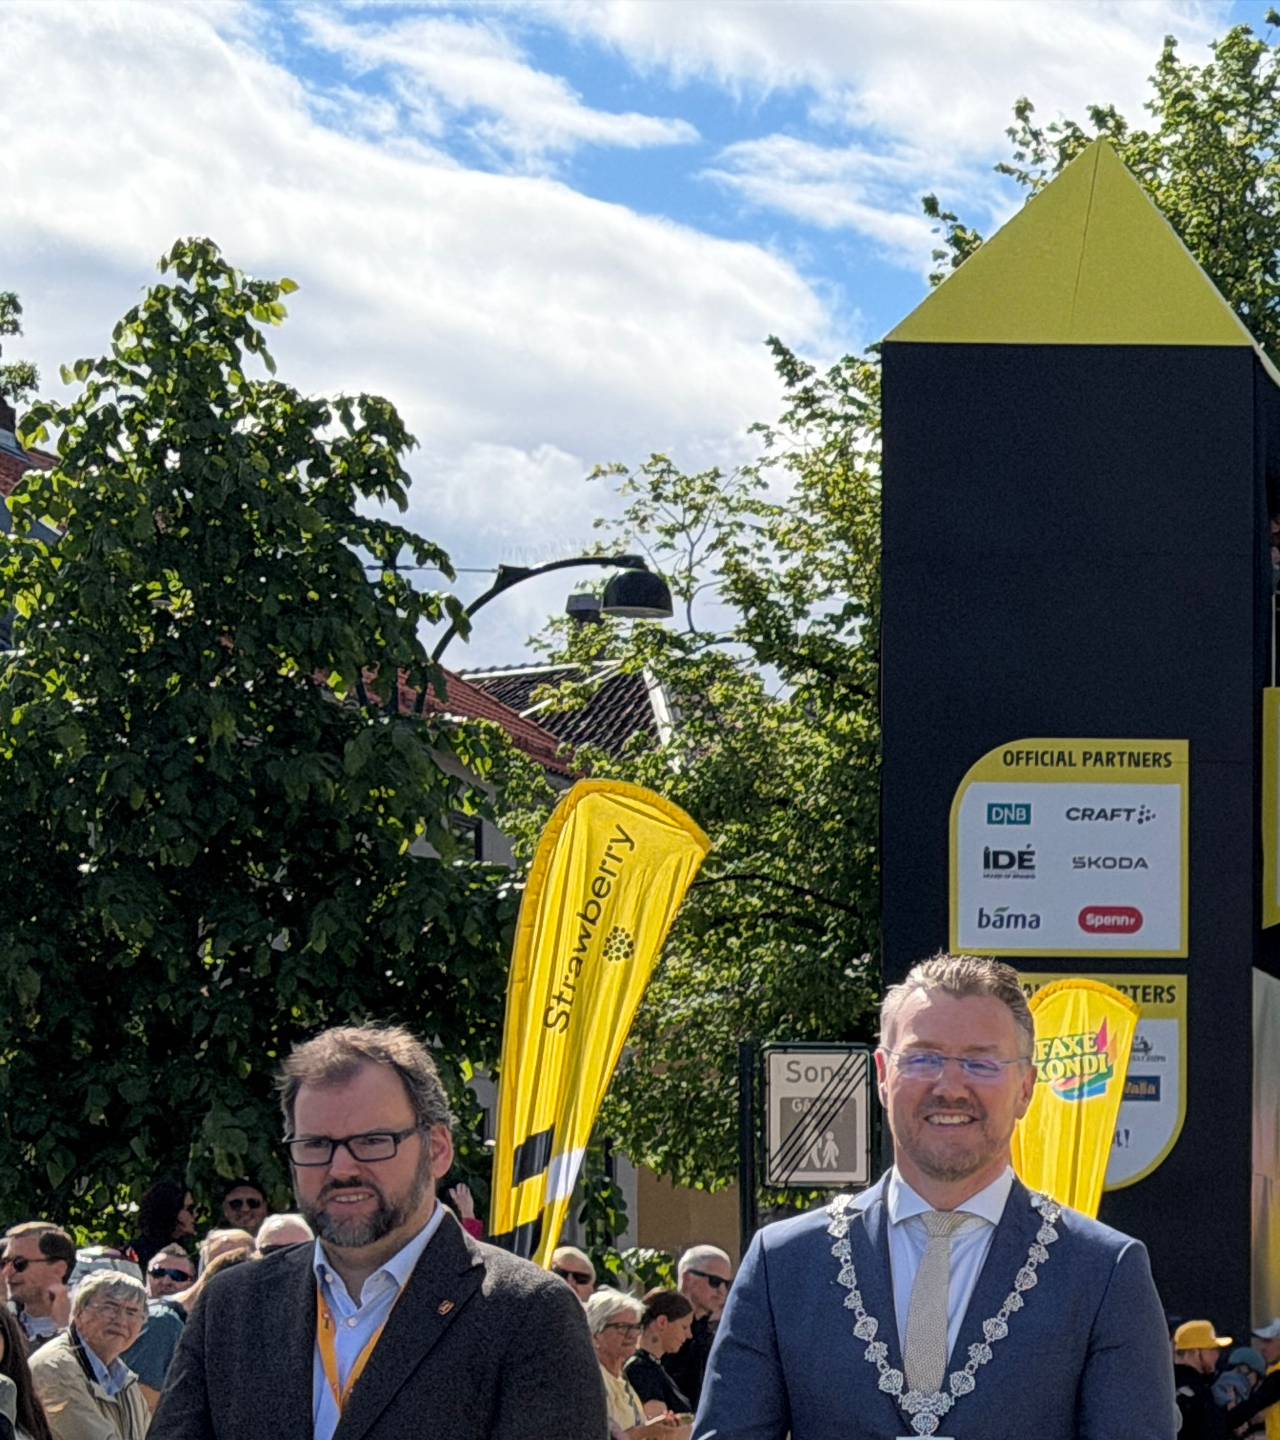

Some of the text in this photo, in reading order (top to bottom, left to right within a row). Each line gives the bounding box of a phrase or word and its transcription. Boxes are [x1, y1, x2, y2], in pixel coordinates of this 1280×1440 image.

[1003, 750, 1173, 769] OFFICIAL PARTNERS
[991, 807, 1027, 822] DNB
[1065, 807, 1137, 822] CRAFT
[543, 824, 635, 1035] Strawberry
[1036, 1032, 1099, 1061] FAXE
